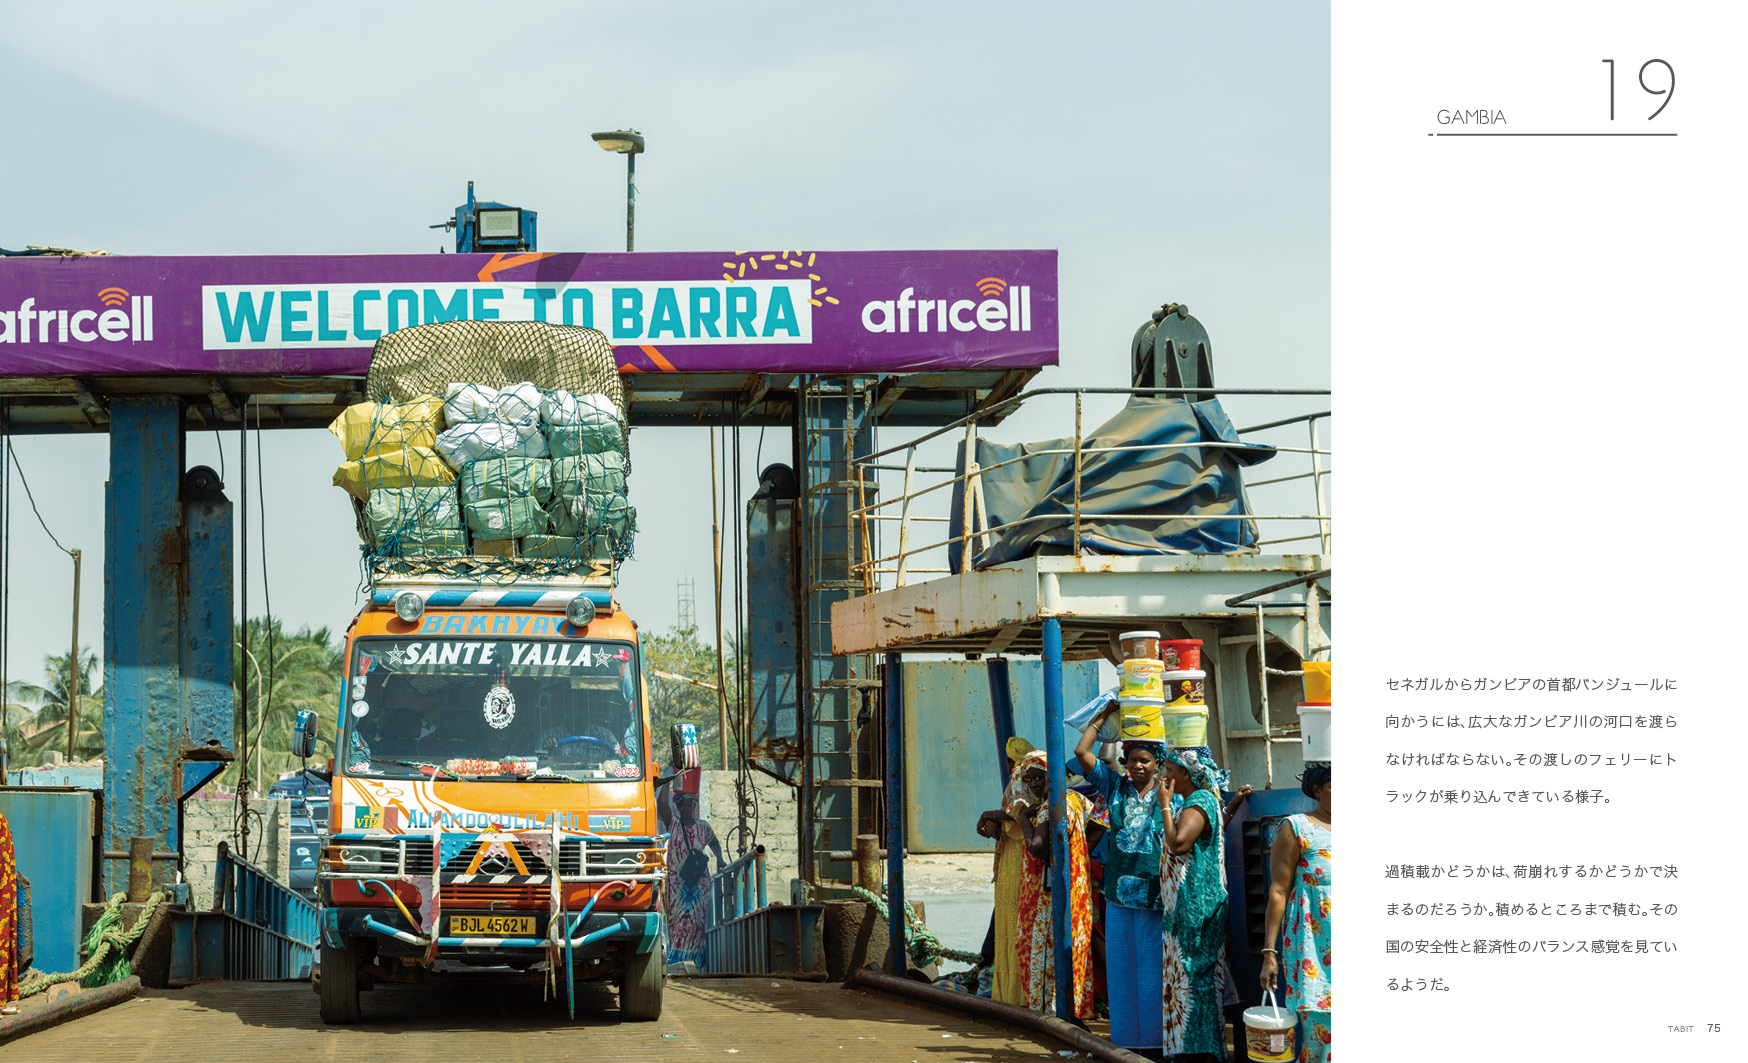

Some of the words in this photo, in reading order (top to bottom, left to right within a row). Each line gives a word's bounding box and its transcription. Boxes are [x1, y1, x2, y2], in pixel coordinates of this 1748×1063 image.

[215, 287, 505, 343] WELCOME
[523, 286, 594, 333] TO
[611, 285, 801, 343] BARRA
[861, 285, 1031, 333] africell
[404, 642, 497, 665] SANTE
[510, 642, 593, 667] YALLA
[615, 767, 640, 777] 2022
[356, 817, 377, 828] VIP
[602, 818, 624, 830] VIP
[460, 918, 485, 932] BJL
[487, 918, 518, 932] 4562
[520, 918, 529, 933] W
